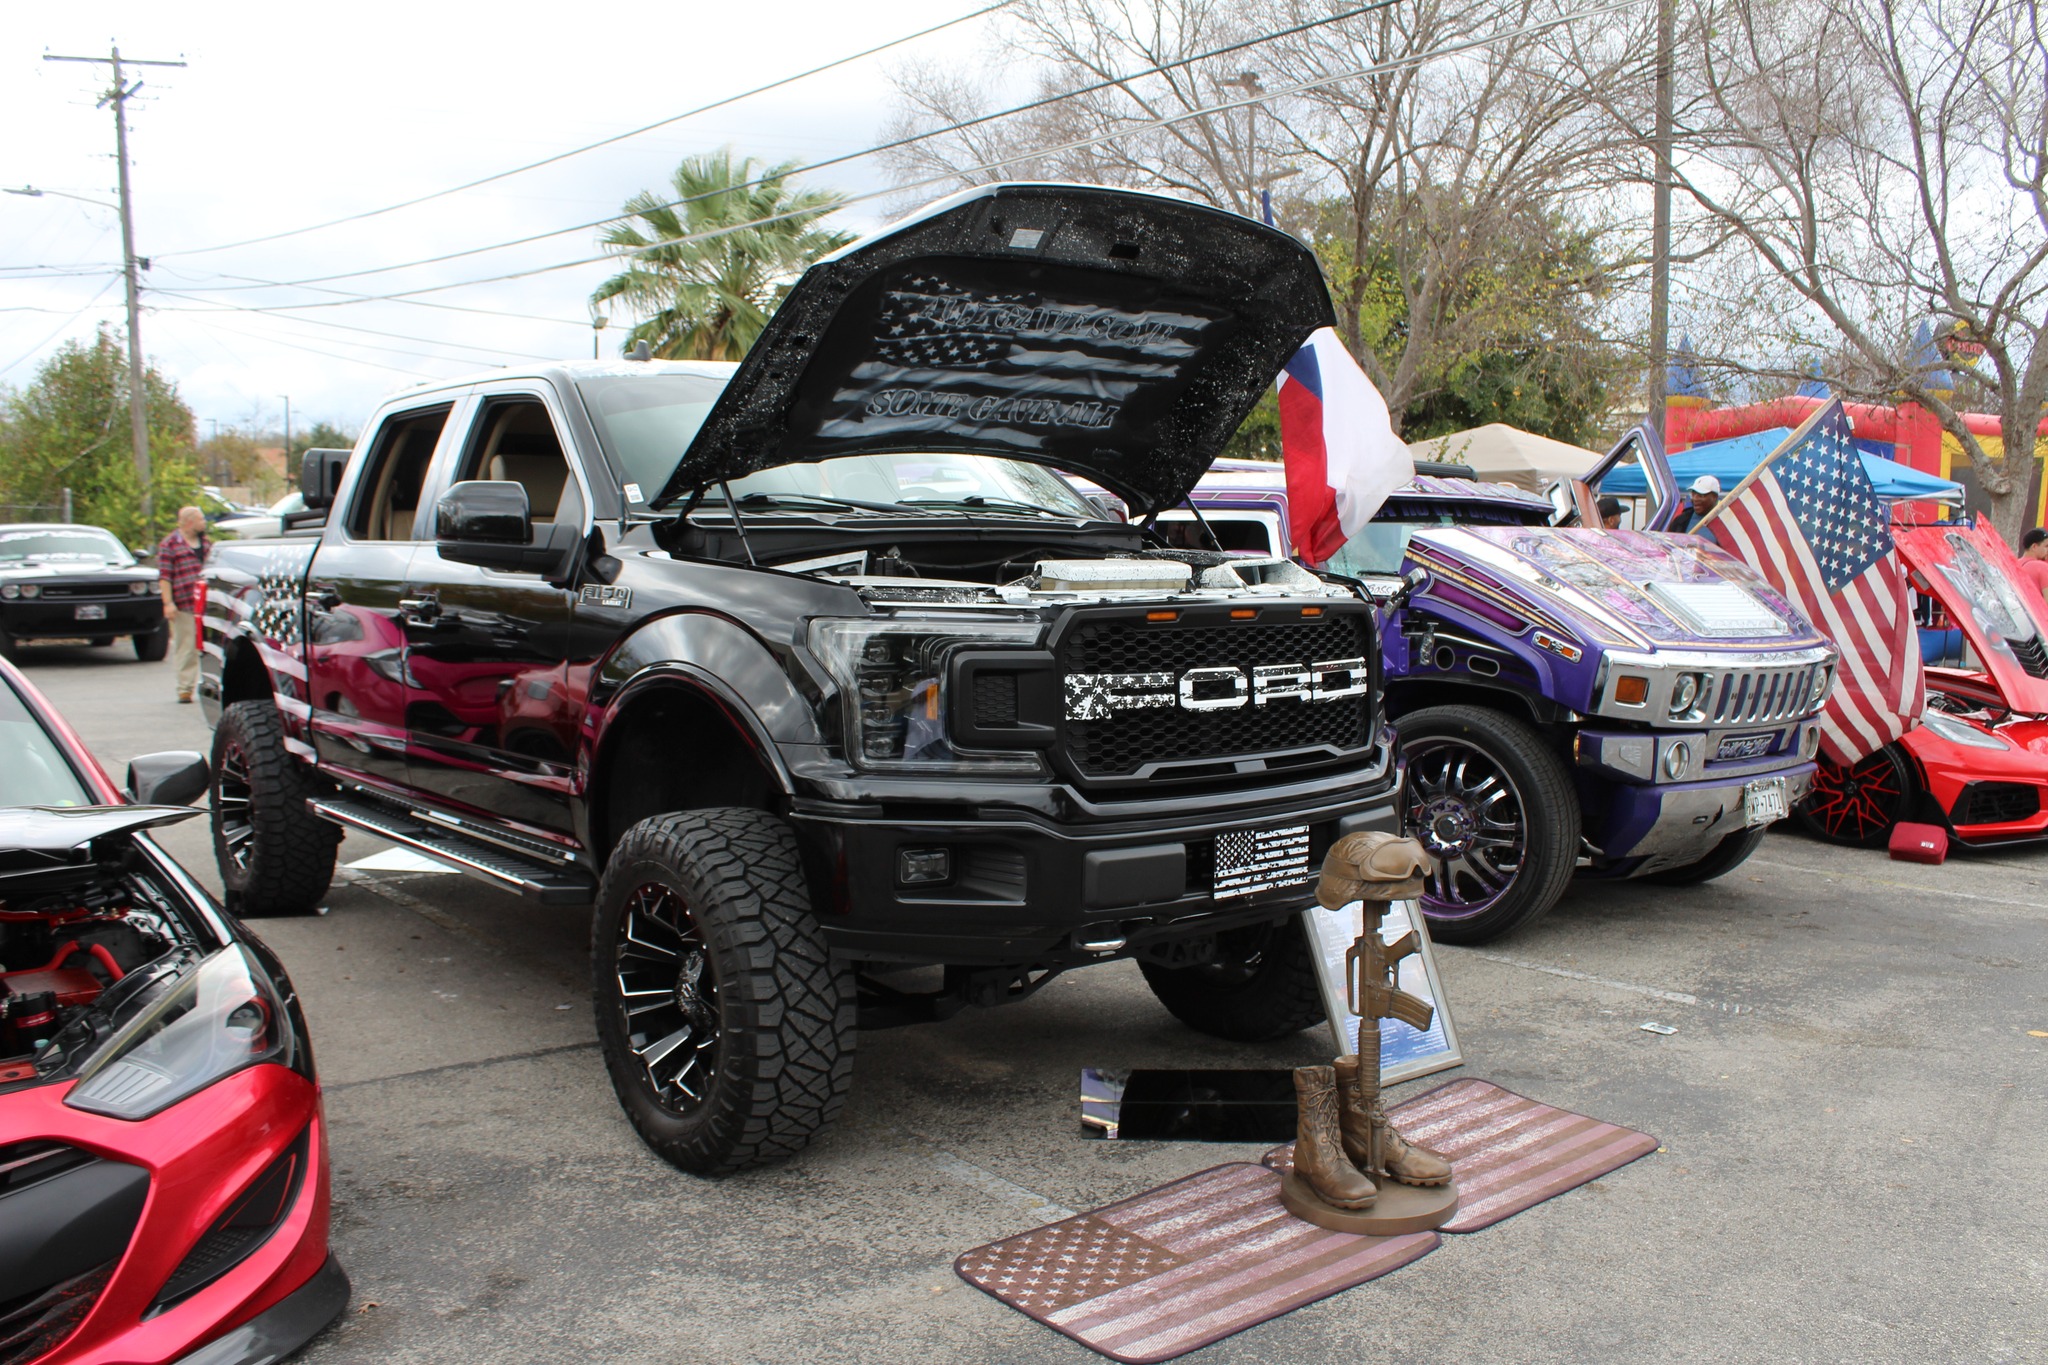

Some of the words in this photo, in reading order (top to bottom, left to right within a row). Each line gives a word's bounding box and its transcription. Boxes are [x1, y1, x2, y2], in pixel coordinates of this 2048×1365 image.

[919, 296, 989, 326] ALL
[996, 306, 1089, 333] GAVE
[1090, 316, 1177, 346] SOME
[866, 389, 966, 417] SOME
[970, 396, 1056, 424] GAVE
[1057, 402, 1120, 428] ALL
[1065, 658, 1367, 719] FORD
[1731, 689, 1806, 700] HUMMER
